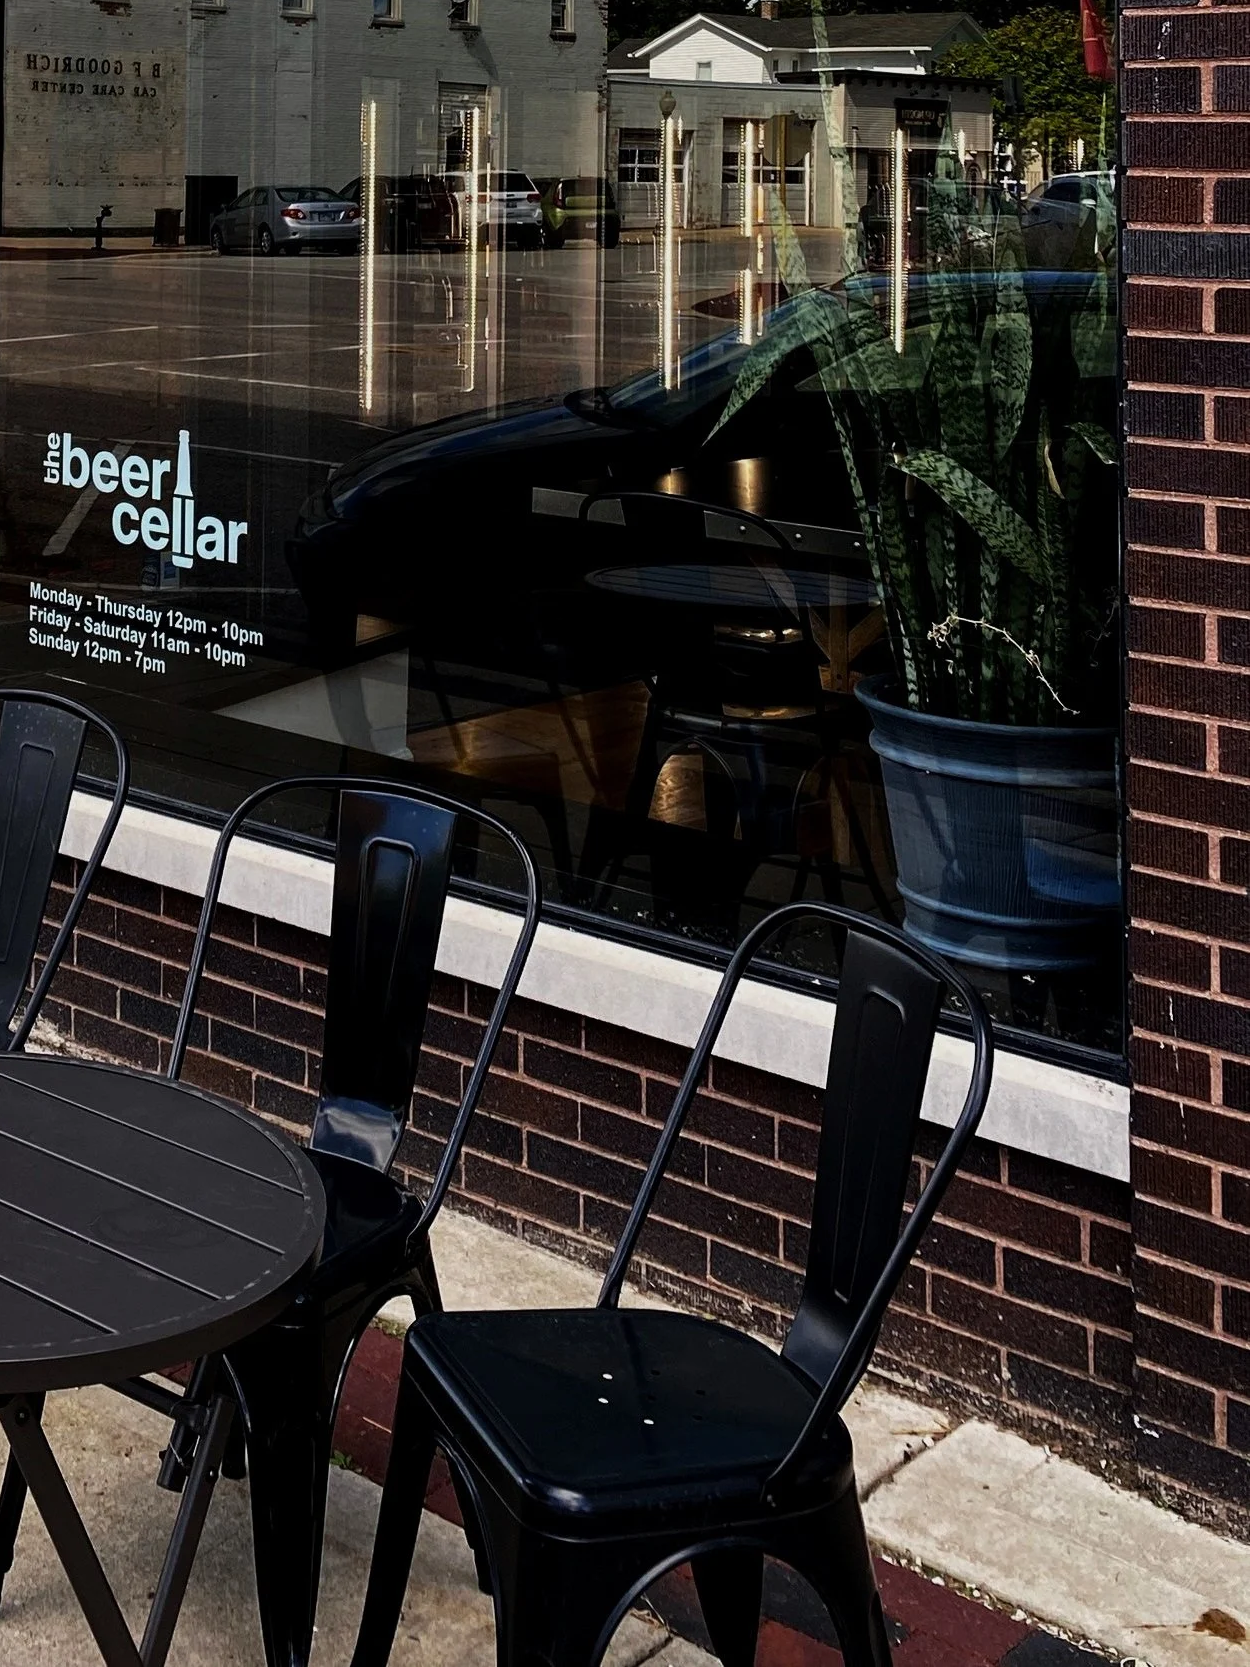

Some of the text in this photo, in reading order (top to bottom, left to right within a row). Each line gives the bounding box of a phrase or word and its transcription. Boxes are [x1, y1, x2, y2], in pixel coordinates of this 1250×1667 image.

[43, 432, 60, 484] the
[62, 432, 170, 500] beer
[112, 496, 248, 564] cellar
[29, 605, 71, 633] Friday
[83, 615, 147, 649] Saturday
[151, 630, 190, 655] 11am
[204, 642, 246, 667] 10pm
[30, 581, 83, 611] Monday
[95, 594, 162, 628] Thursday
[167, 609, 207, 634] 12pm
[221, 620, 264, 646] 10pm
[29, 627, 80, 658] Sunday
[83, 639, 121, 664] 12pm
[134, 650, 166, 674] 7pm
